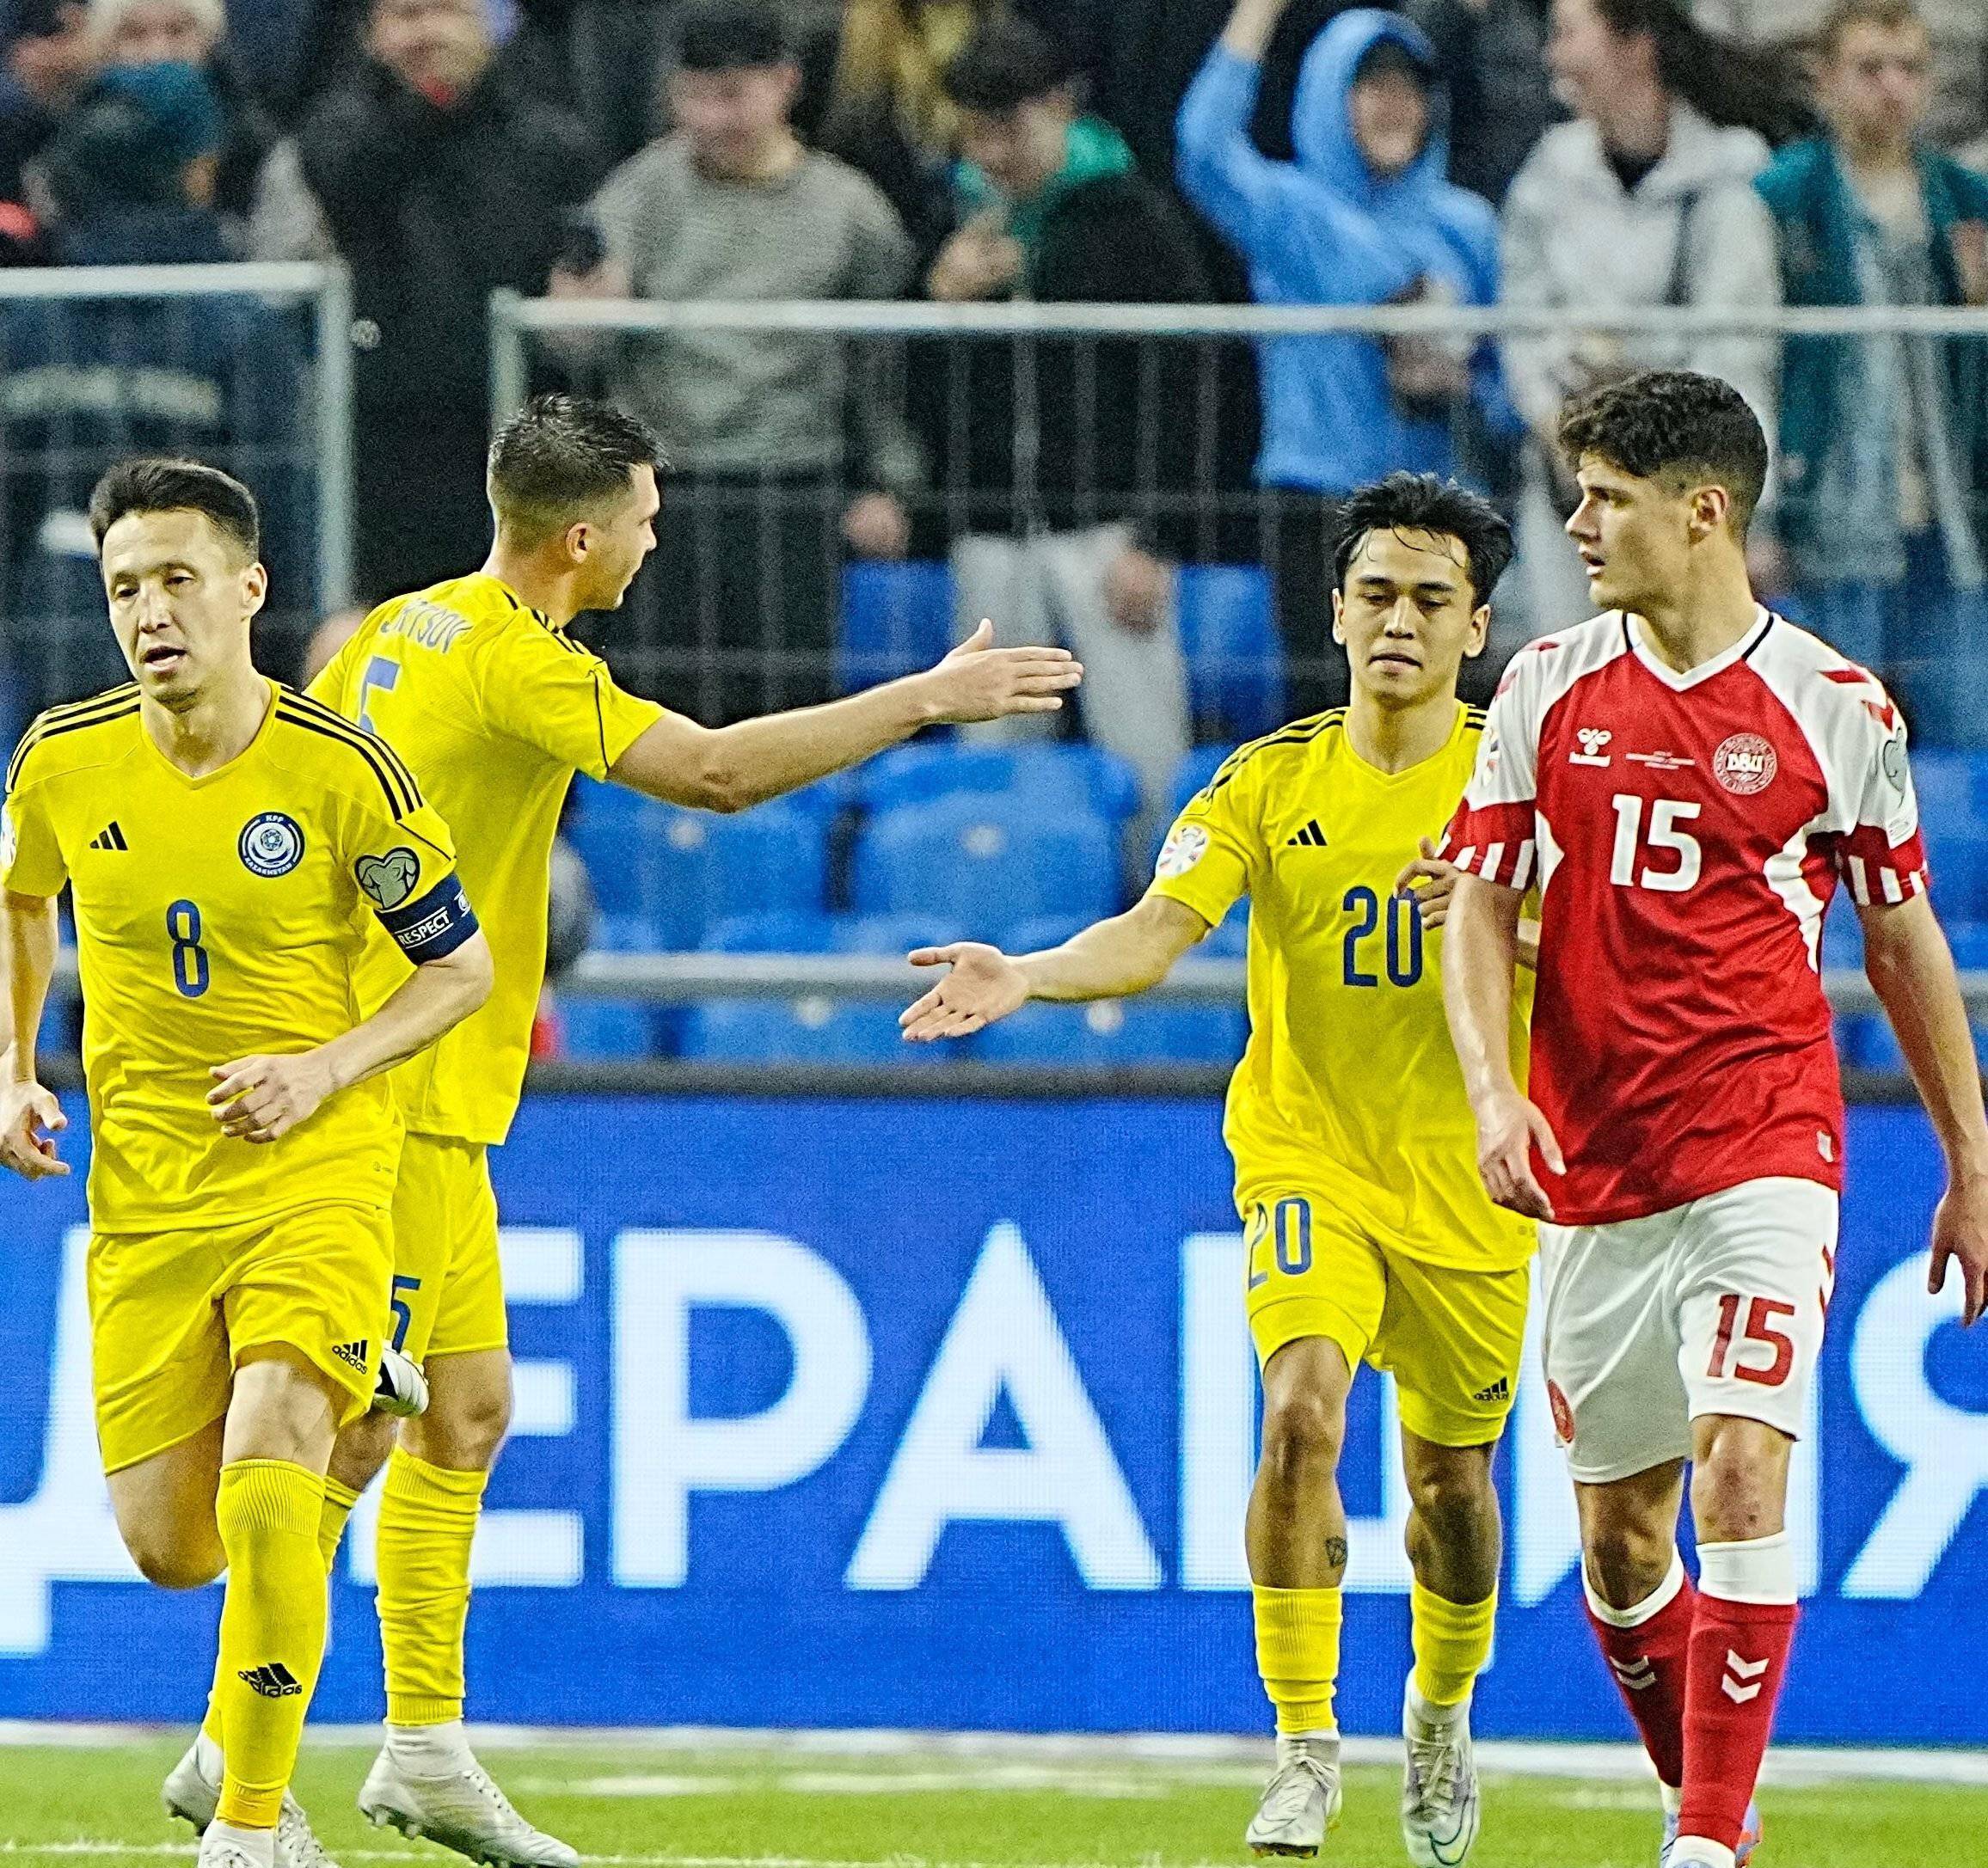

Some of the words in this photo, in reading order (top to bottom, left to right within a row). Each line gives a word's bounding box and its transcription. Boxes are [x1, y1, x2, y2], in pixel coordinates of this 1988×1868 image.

[1610, 793, 1702, 891] 15
[167, 899, 210, 998] 8
[398, 910, 451, 945] RESPECT
[1343, 885, 1423, 987] 20
[1248, 1197, 1312, 1291] 20
[332, 1345, 368, 1375] adidas
[390, 1274, 421, 1355] 5
[1706, 1294, 1795, 1386] 15
